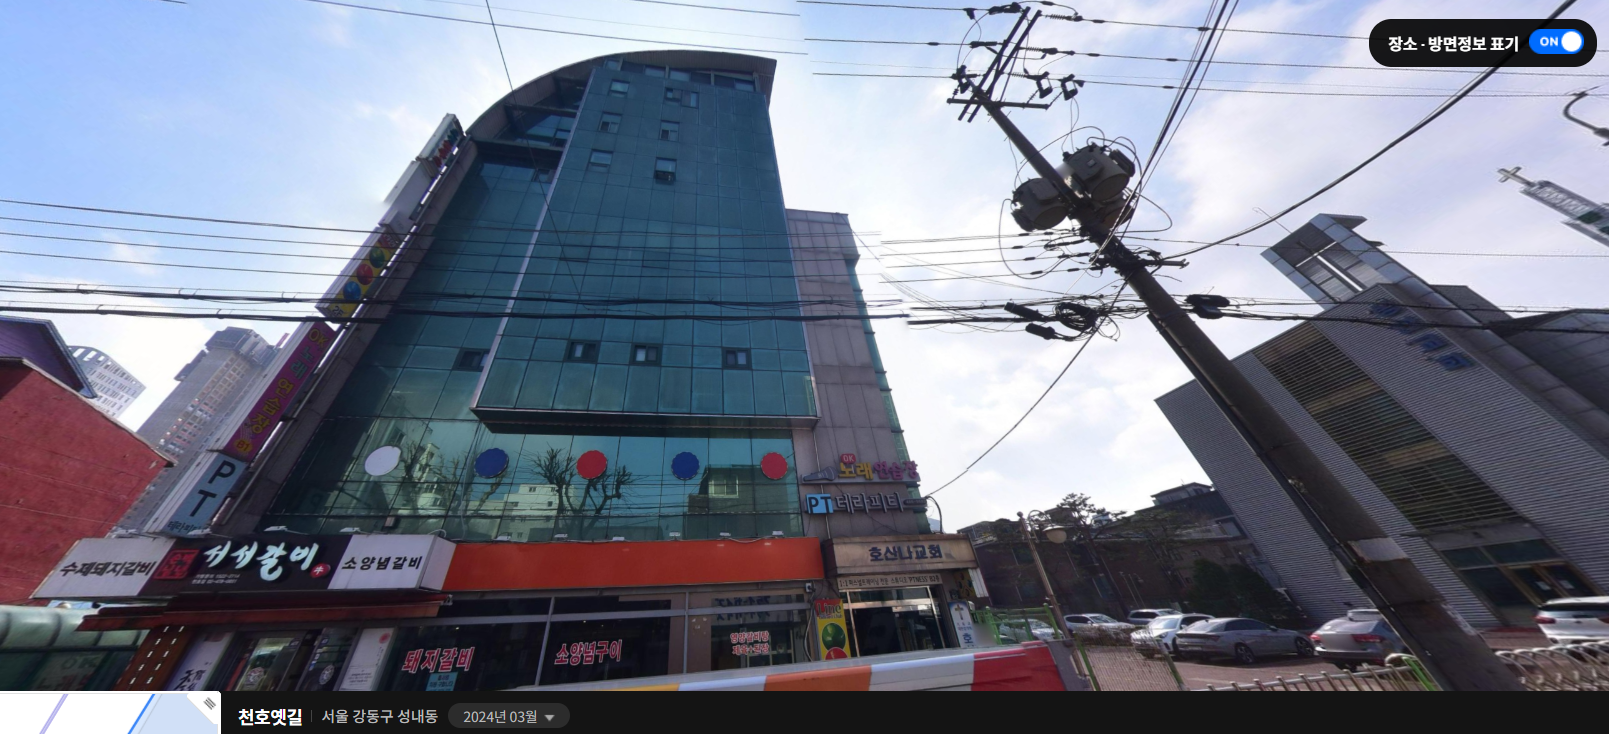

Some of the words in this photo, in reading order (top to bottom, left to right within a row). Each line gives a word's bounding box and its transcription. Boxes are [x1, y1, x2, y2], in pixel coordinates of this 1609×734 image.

[843, 454, 855, 463] OK
[188, 459, 237, 518] PT
[807, 496, 834, 514] PT
[836, 492, 904, 514] 테라피티
[203, 540, 320, 581] 서서갈비
[341, 556, 423, 570] 소양념갈비
[868, 544, 943, 562] 호산나교회
[60, 561, 158, 577] 수제돼지갈비
[402, 647, 475, 673] 돼지갈비
[554, 639, 622, 665] 소양념구이
